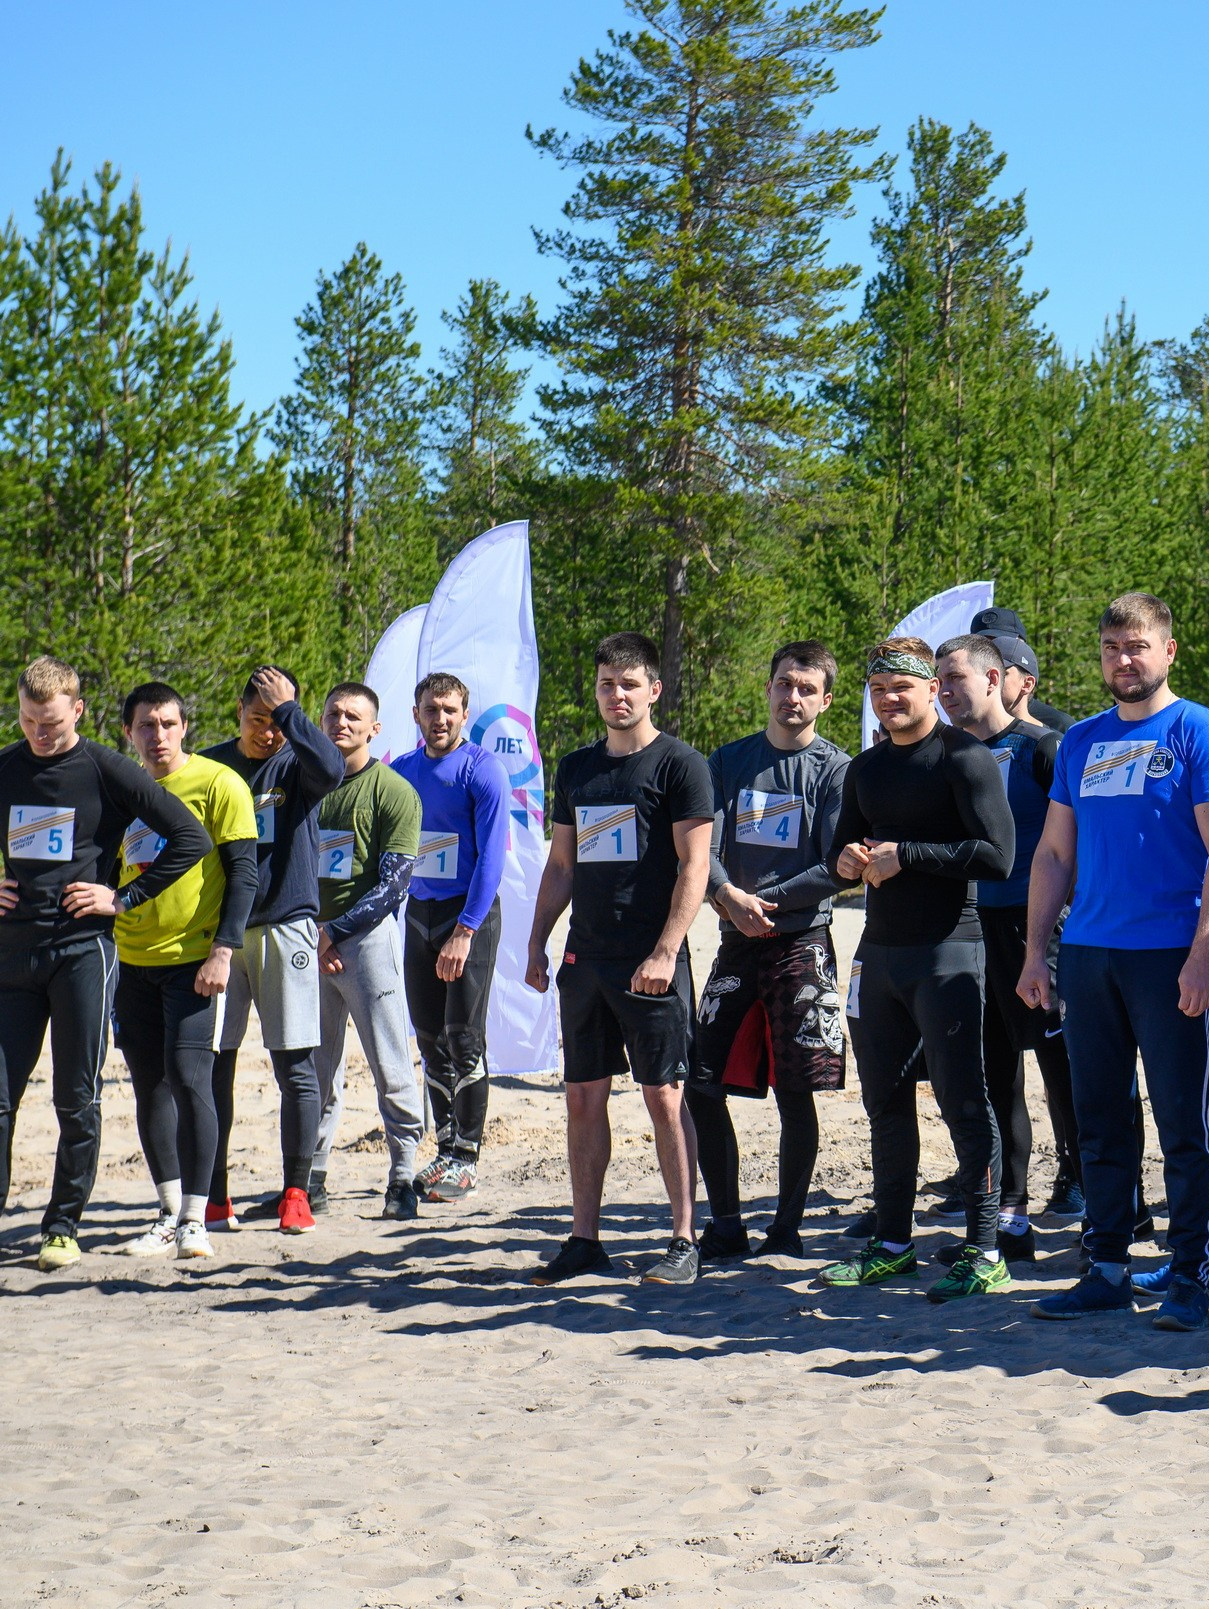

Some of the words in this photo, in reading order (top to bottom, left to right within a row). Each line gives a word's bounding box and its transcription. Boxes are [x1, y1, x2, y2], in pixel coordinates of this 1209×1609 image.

[494, 737, 523, 754] ЛЕТ
[1096, 745, 1105, 759] 3
[1083, 769, 1114, 785] ЯМАЛЬСКИЙ
[1125, 762, 1137, 787] 1
[746, 793, 754, 807] 7
[16, 810, 23, 823] 1
[581, 810, 588, 825] 7
[775, 816, 789, 841] 4
[48, 829, 63, 854] 5
[611, 828, 622, 854] 1
[329, 850, 344, 873] 2
[436, 851, 446, 872] 1
